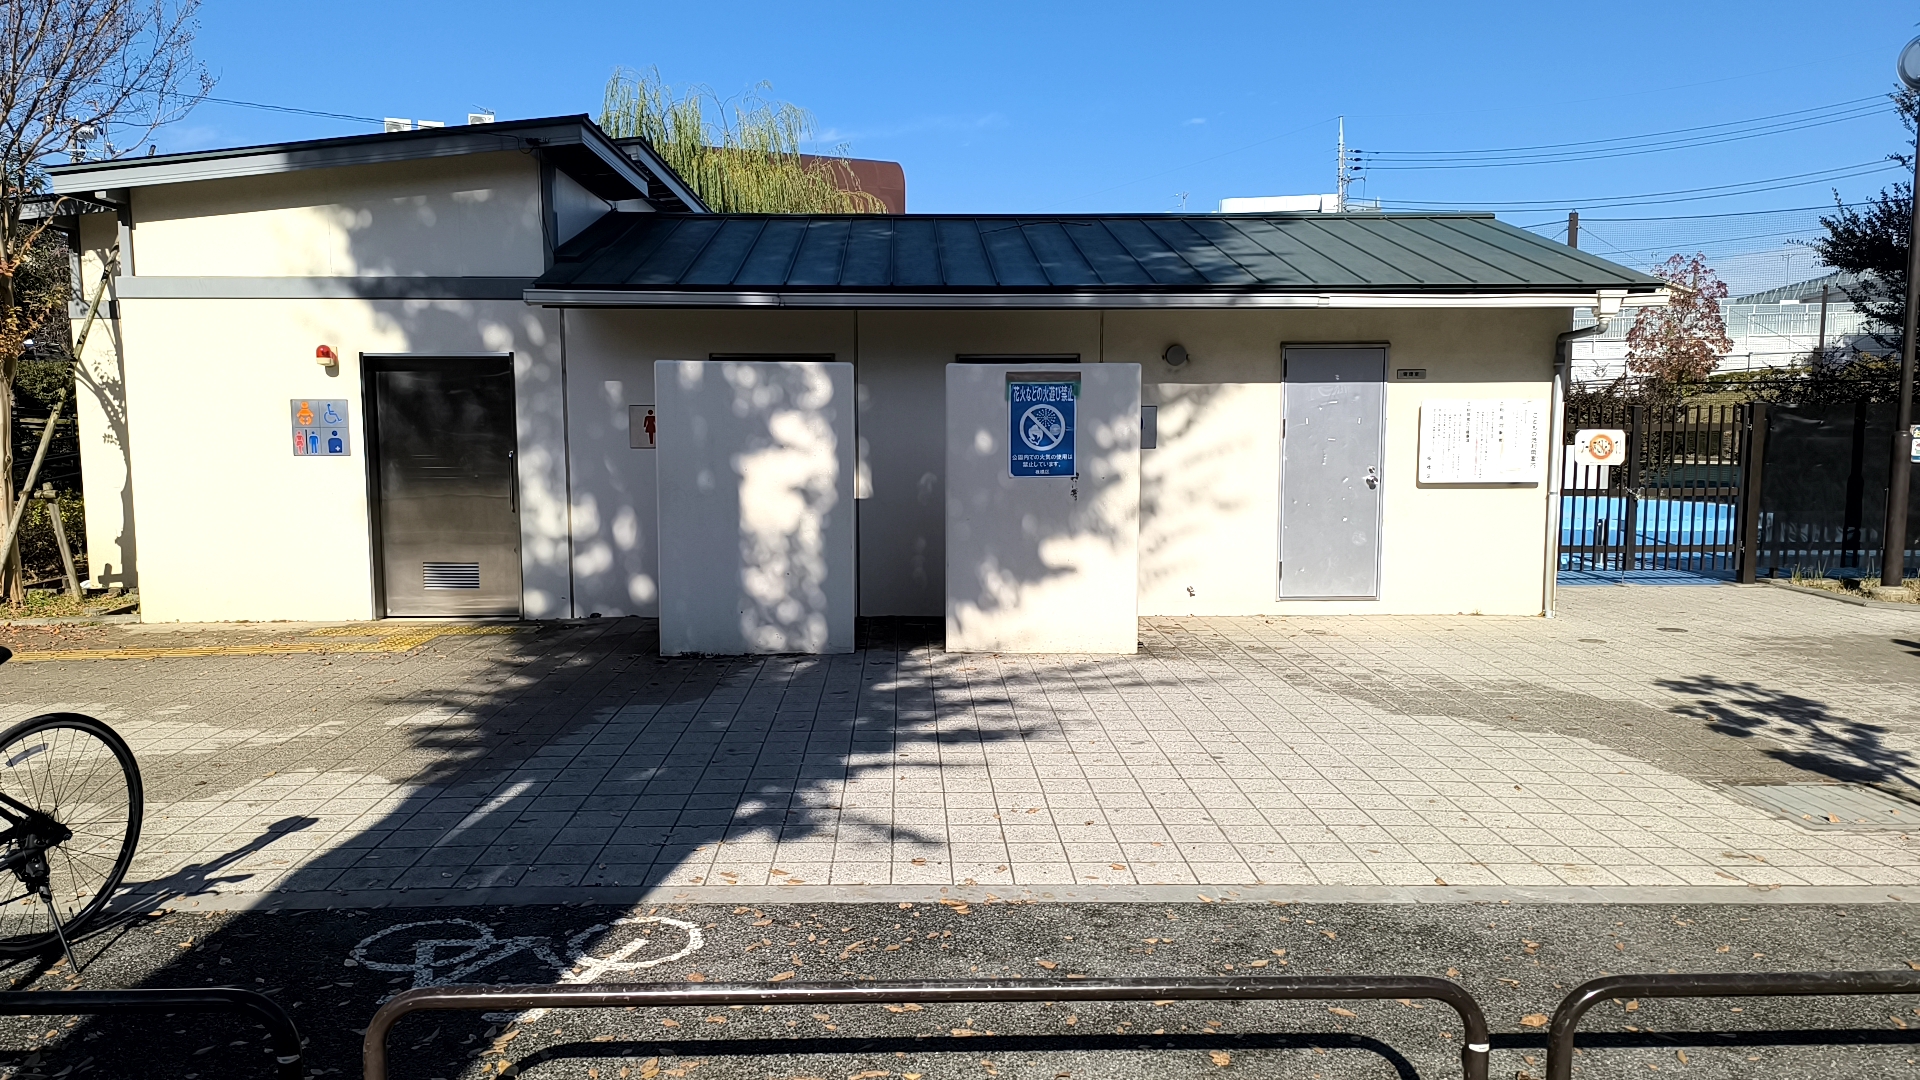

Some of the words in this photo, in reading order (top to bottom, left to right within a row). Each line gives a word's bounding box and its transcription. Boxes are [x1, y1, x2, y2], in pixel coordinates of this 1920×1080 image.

[1013, 385, 1074, 402] 花火などの火遊び禁止
[1012, 453, 1073, 461] 公園内での火気の使用は
